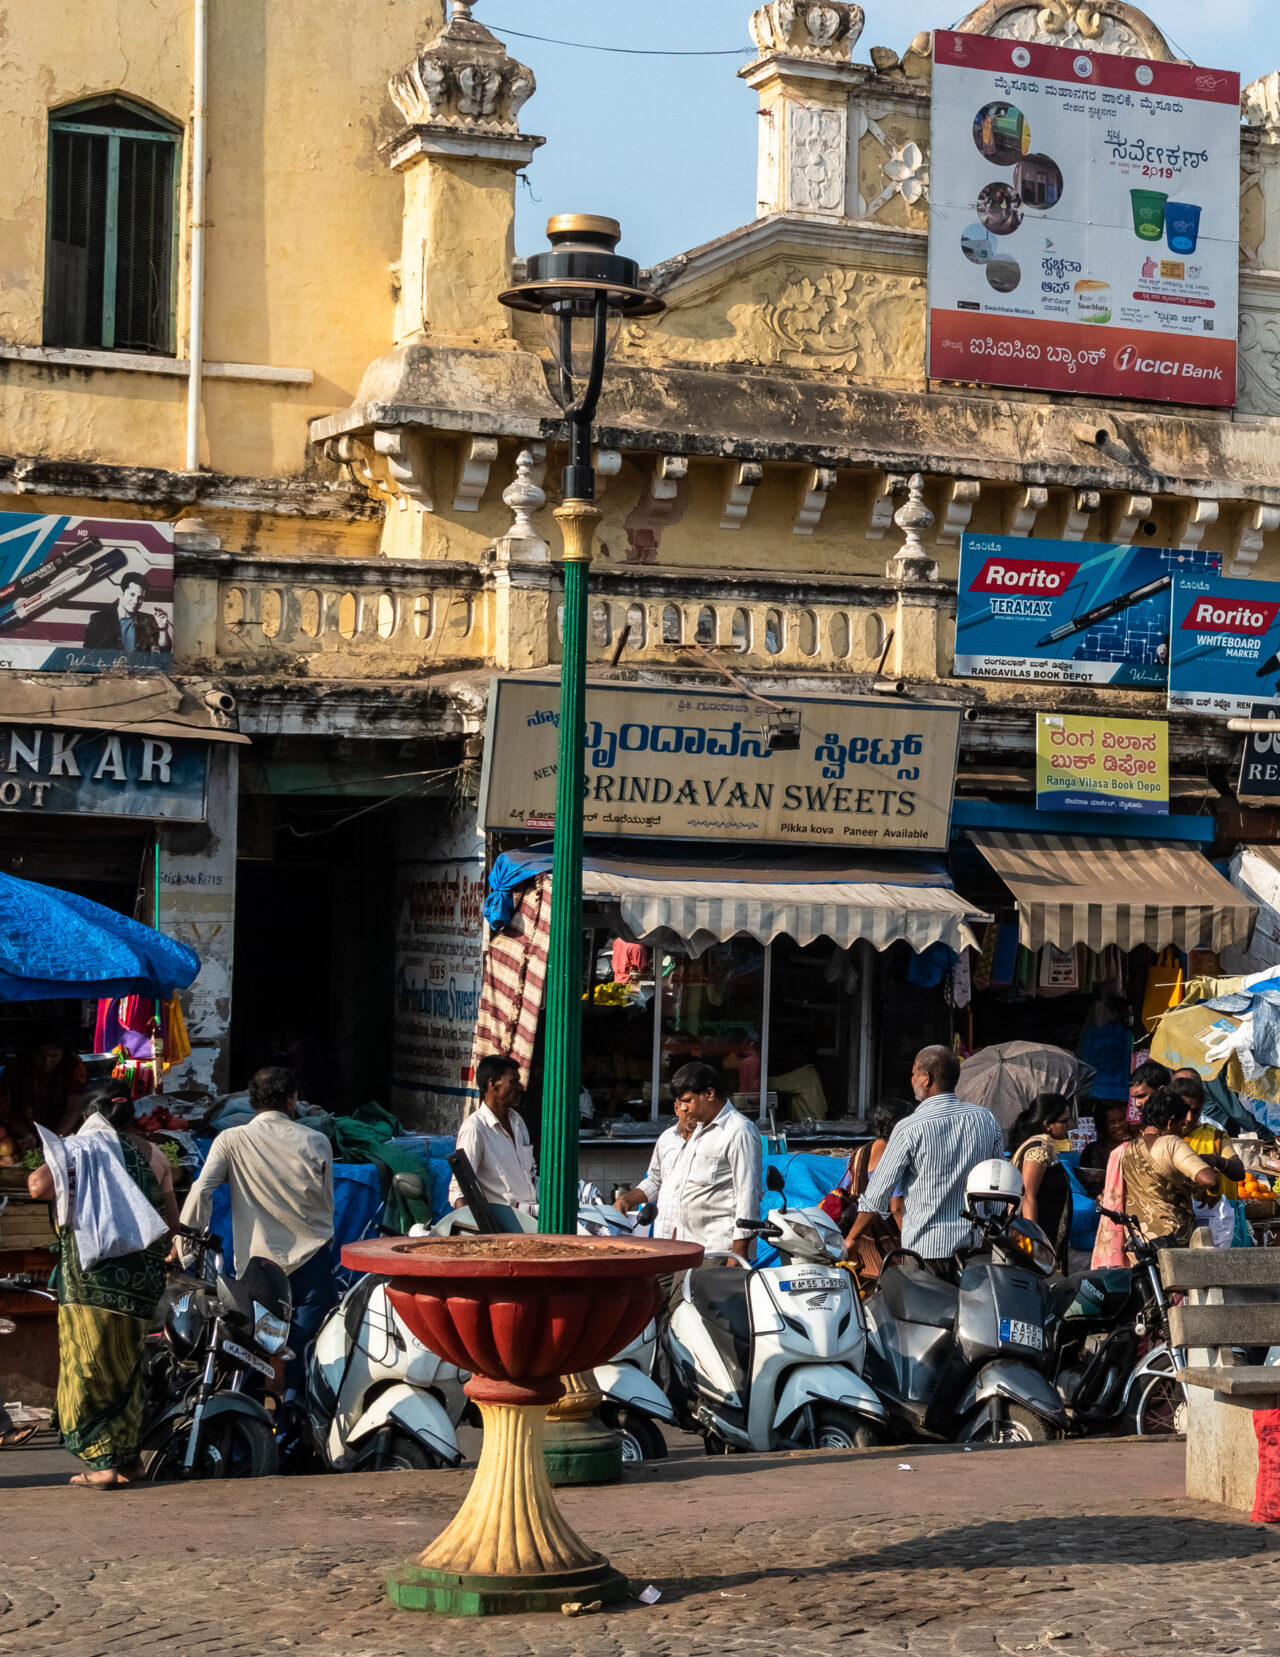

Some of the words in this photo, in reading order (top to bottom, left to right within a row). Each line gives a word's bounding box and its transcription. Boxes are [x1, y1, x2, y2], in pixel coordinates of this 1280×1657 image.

[994, 77, 1039, 95] ಮೈಸೂರು
[1045, 85, 1097, 101] ಮಹಾನಗರ
[1140, 96, 1184, 115] ಮೈಸೂರು
[969, 337, 1041, 360] ಐಸಿಐಸಿಐ
[1047, 345, 1107, 374] ಬ್ಯಾಂಕ್
[1134, 358, 1179, 376] ICICI
[1181, 363, 1224, 381] Bank
[77, 529, 88, 537] HD
[21, 561, 55, 585] PERMANENT
[985, 565, 1061, 589] Rorito
[990, 598, 1053, 616] TERAMAX
[1196, 603, 1265, 628] Rorito
[1197, 635, 1261, 649] WHITEBOARD
[1225, 648, 1259, 659] MARKER
[971, 667, 1031, 678] RANGAVILAS
[1033, 670, 1060, 680] BOOK
[1063, 672, 1093, 682] DEPOT
[1050, 727, 1095, 747] ರಂಗ
[1101, 731, 1157, 751] ವಿಲಾಸ
[0, 729, 173, 783] NKAR
[1051, 753, 1096, 770] ಬುಕ್
[1103, 753, 1157, 777] ಡಿಪೋ
[0, 780, 51, 807] OT
[1046, 775, 1076, 789] Ranga
[1079, 777, 1109, 789] Vilasa
[1111, 779, 1134, 790] Book
[1137, 780, 1161, 793] Depo
[782, 782, 918, 818] SWEETS
[781, 823, 808, 834] Pikka
[810, 823, 834, 835] kova
[843, 826, 878, 837] Paneer
[883, 828, 929, 839] Available
[430, 964, 446, 980] NBS
[1011, 1331, 1042, 1348] E7153
